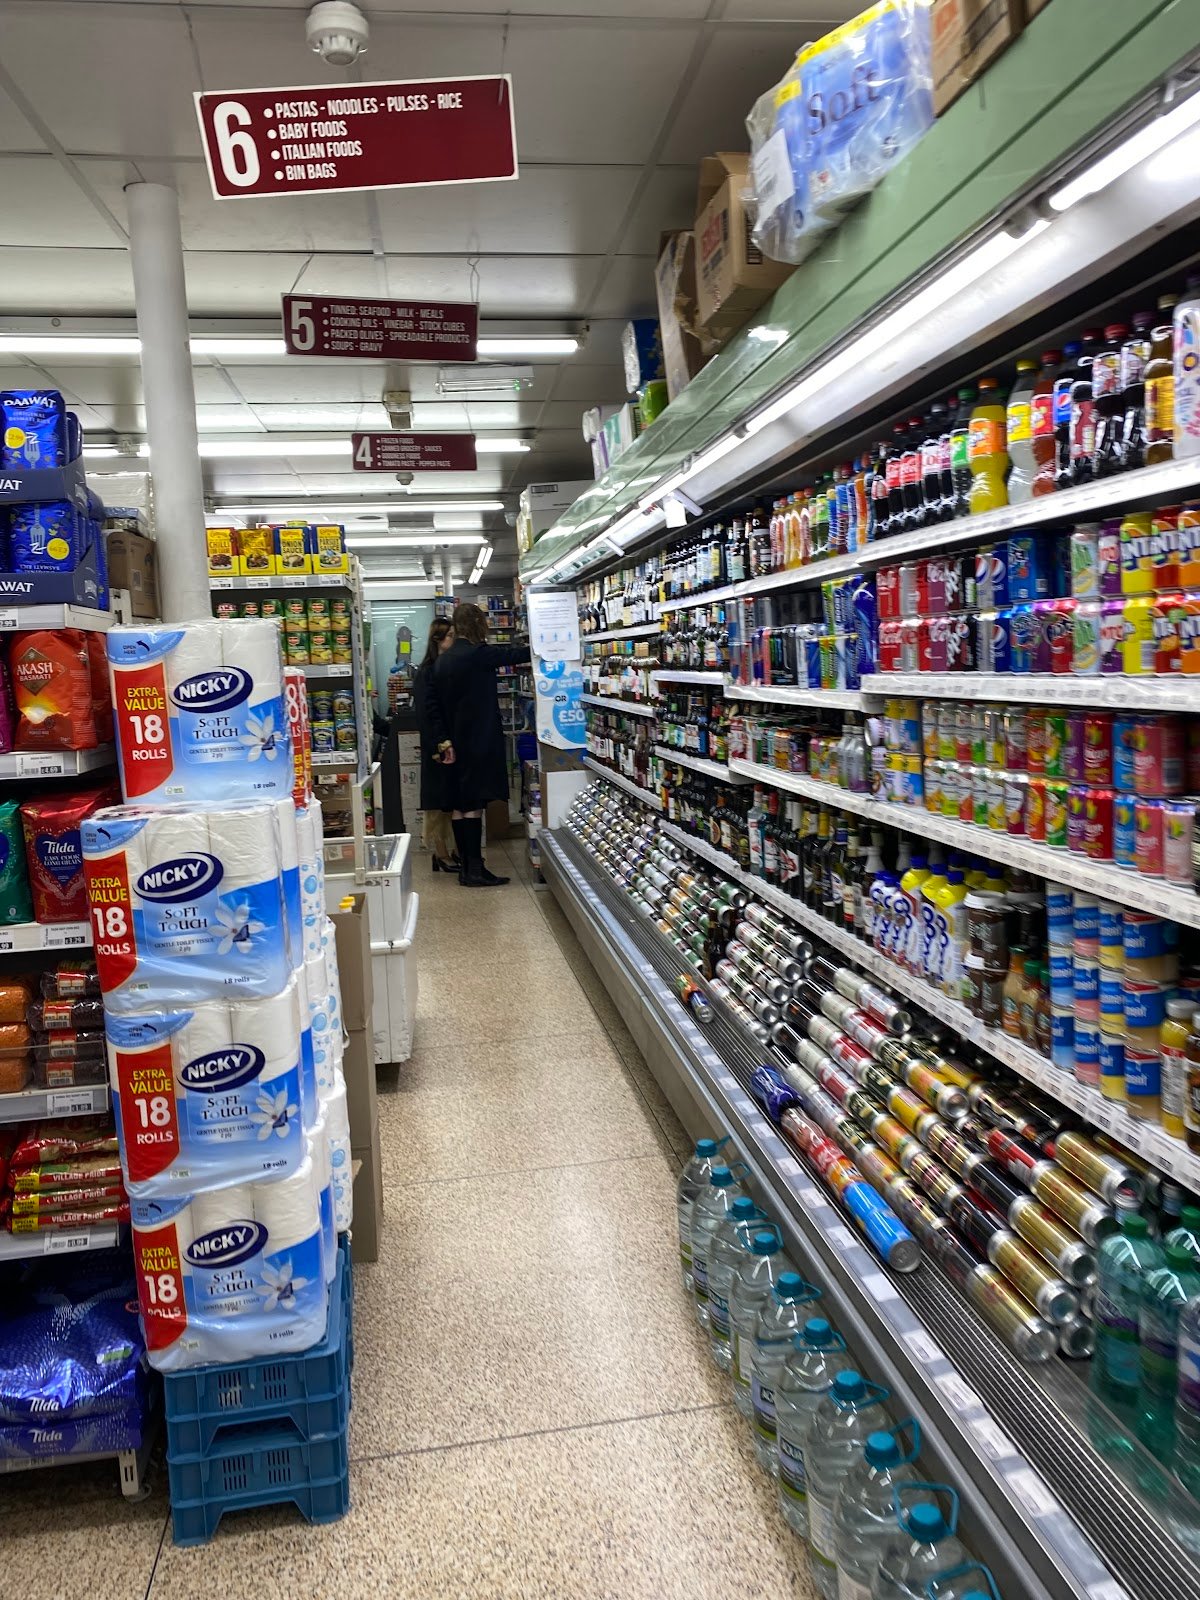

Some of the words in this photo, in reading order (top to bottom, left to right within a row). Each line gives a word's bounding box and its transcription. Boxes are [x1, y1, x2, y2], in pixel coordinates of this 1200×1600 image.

[275, 101, 319, 119] PASTAS
[328, 97, 378, 117] NOODLES
[387, 95, 430, 113] PULSES
[437, 92, 463, 110] RICE
[807, 64, 880, 136] Soft
[279, 122, 310, 140] BABY
[311, 120, 348, 138] FOODS
[213, 101, 261, 188] 6
[282, 142, 326, 161] ITALIAN
[327, 140, 363, 158] FOODS
[286, 164, 307, 181] BIN
[308, 162, 337, 180] BAGS
[358, 306, 391, 317] SEAFOOD
[290, 301, 316, 351] 5
[4, 396, 56, 409] DAAWAT
[355, 436, 373, 468] 4
[17, 662, 54, 676] AKASH
[20, 673, 52, 682] BASMATI
[127, 687, 160, 698] EXTRA
[179, 674, 233, 701] NICKY
[124, 698, 165, 711] VALUE
[555, 695, 568, 703] OR
[129, 715, 165, 744] 18
[132, 749, 168, 761] ROLLS
[43, 841, 75, 854] Tilda
[90, 877, 121, 888] EXTRA
[143, 861, 201, 890] NICKY
[88, 889, 127, 903] VALUE
[93, 906, 127, 938] 18
[97, 942, 130, 955] ROLLS
[234, 976, 250, 984] rolls
[187, 1052, 244, 1080] NICKY
[133, 1068, 167, 1080] EXTRA
[129, 1079, 172, 1094] VALUE
[135, 1097, 171, 1128] 18
[137, 1131, 174, 1144] ROLLS
[53, 1173, 83, 1182] VILLAGE
[84, 1170, 106, 1179] PRIDE
[53, 1193, 83, 1203] VILLAGE
[84, 1190, 106, 1200] PRIDE
[52, 1214, 82, 1223] VILLAGE
[193, 1228, 247, 1258] NICKY
[142, 1247, 172, 1258] EXTRA
[141, 1256, 178, 1271] VALUE
[145, 1274, 178, 1304] 18
[26, 1397, 59, 1412] Tilda
[28, 1428, 63, 1443] Tilda
